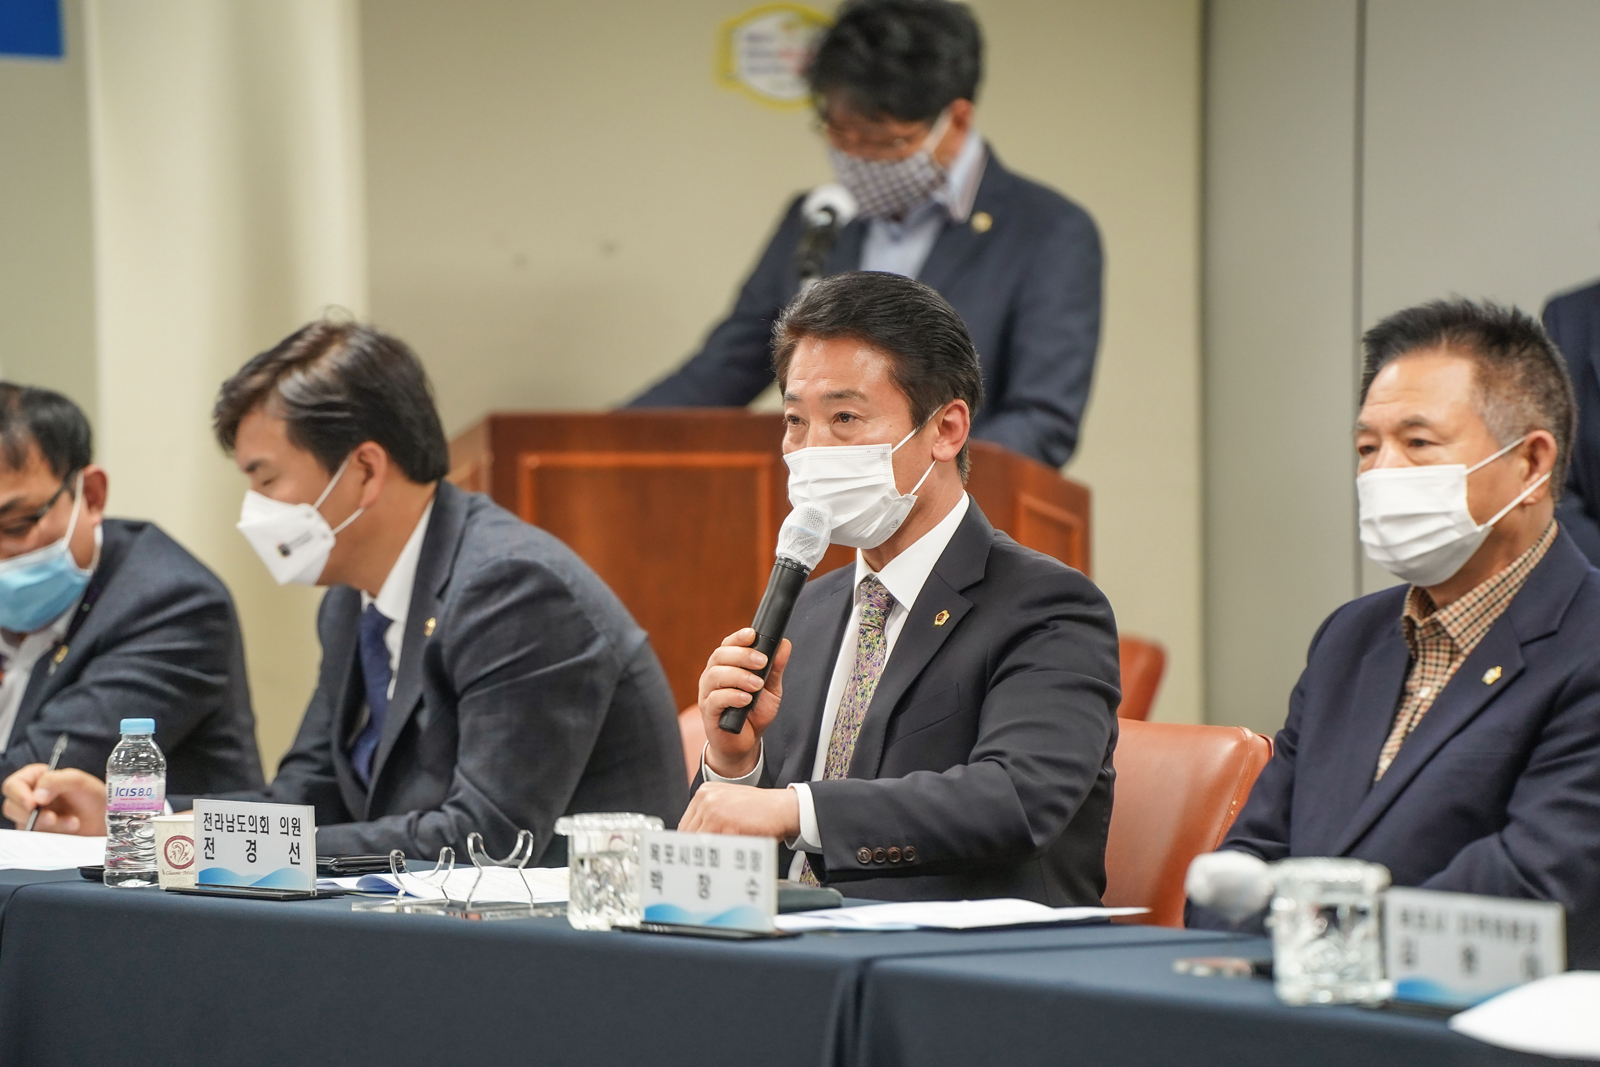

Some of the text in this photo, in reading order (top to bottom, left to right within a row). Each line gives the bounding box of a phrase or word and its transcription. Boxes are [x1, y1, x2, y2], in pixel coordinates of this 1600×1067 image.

[203, 812, 301, 837] 전라남도의회 의원
[203, 836, 301, 866] 전 경 선
